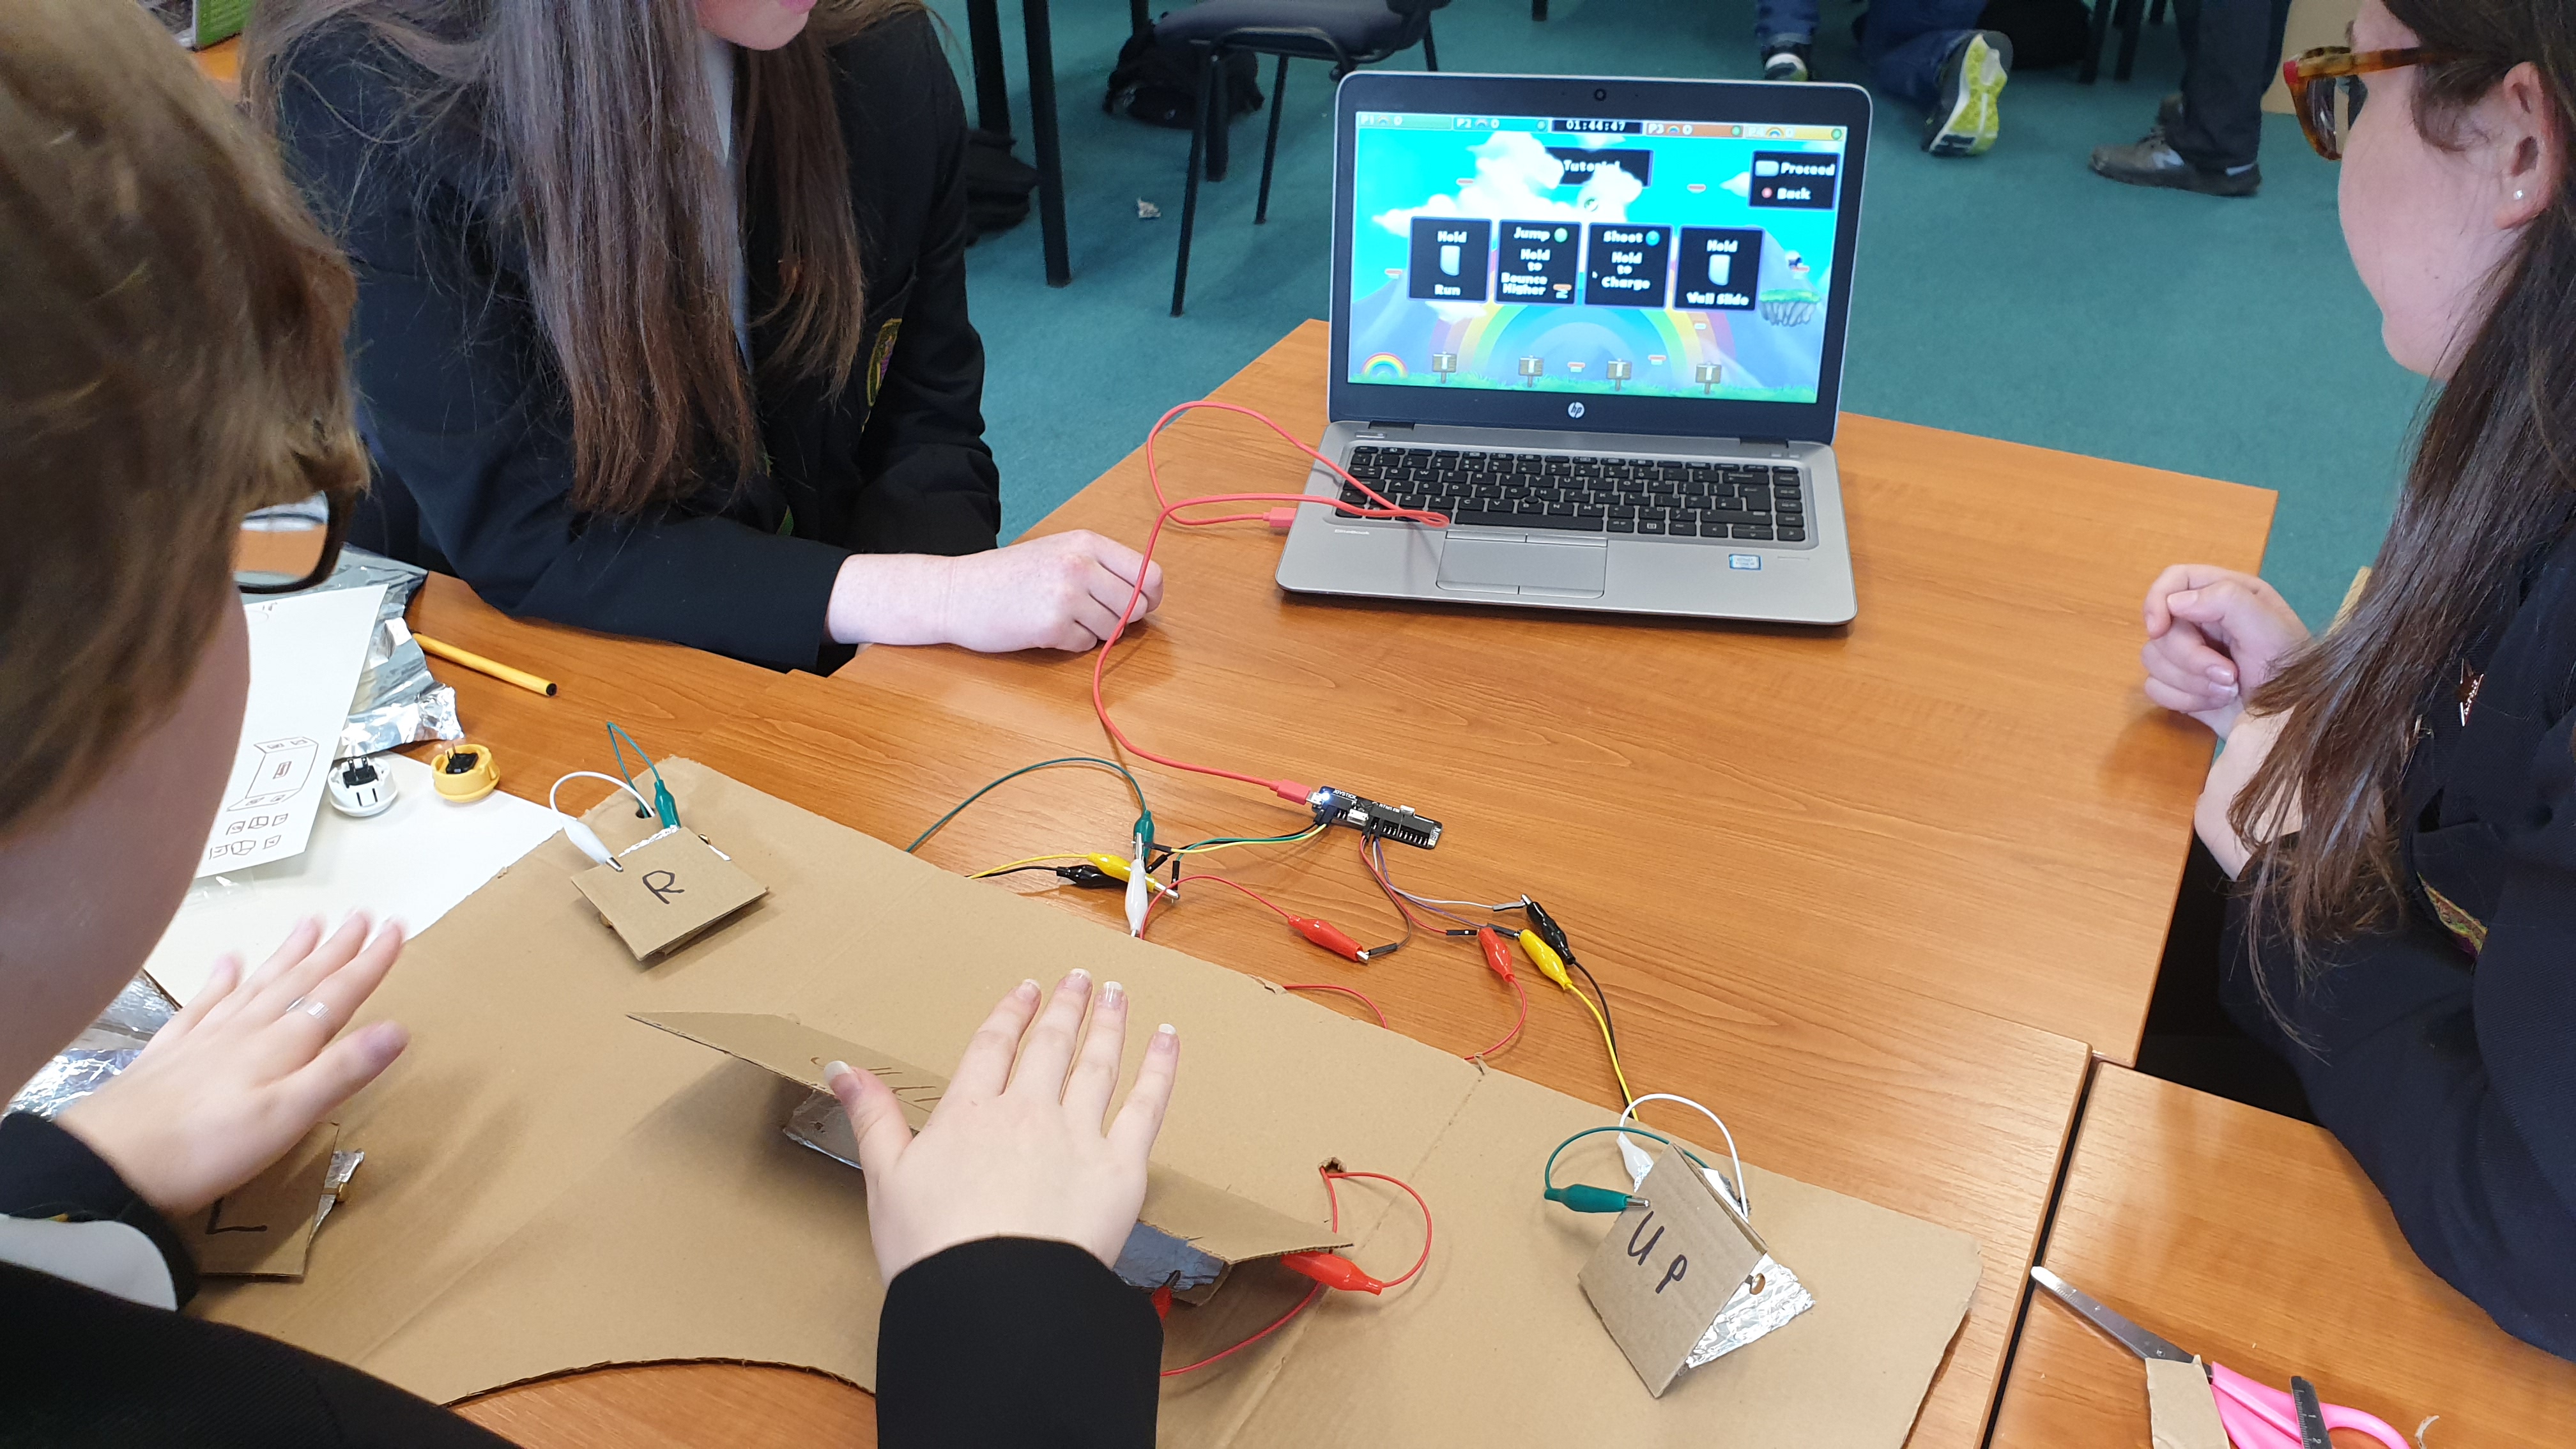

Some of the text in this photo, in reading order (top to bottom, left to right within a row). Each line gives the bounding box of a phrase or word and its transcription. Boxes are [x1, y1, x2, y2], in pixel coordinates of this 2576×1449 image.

[1566, 119, 1626, 132] 01:44:47
[1563, 159, 1621, 172] Tutol
[1781, 162, 1836, 176] Proceed
[1777, 187, 1811, 200] Back
[1438, 231, 1468, 243] Hold
[1514, 227, 1551, 241] Jump
[1603, 230, 1644, 243] Shoot
[1706, 239, 1738, 253] Hold
[1520, 249, 1551, 261] Hold
[1611, 251, 1643, 264] Hold
[1527, 261, 1543, 272] to
[1616, 264, 1632, 275] to
[1501, 272, 1548, 285] Bounce
[1601, 276, 1651, 291] Charge
[1434, 284, 1461, 296] Run
[1503, 283, 1546, 296] Higher
[1686, 291, 1749, 306] Wall Slide
[642, 870, 685, 905] R
[205, 1195, 268, 1235] L
